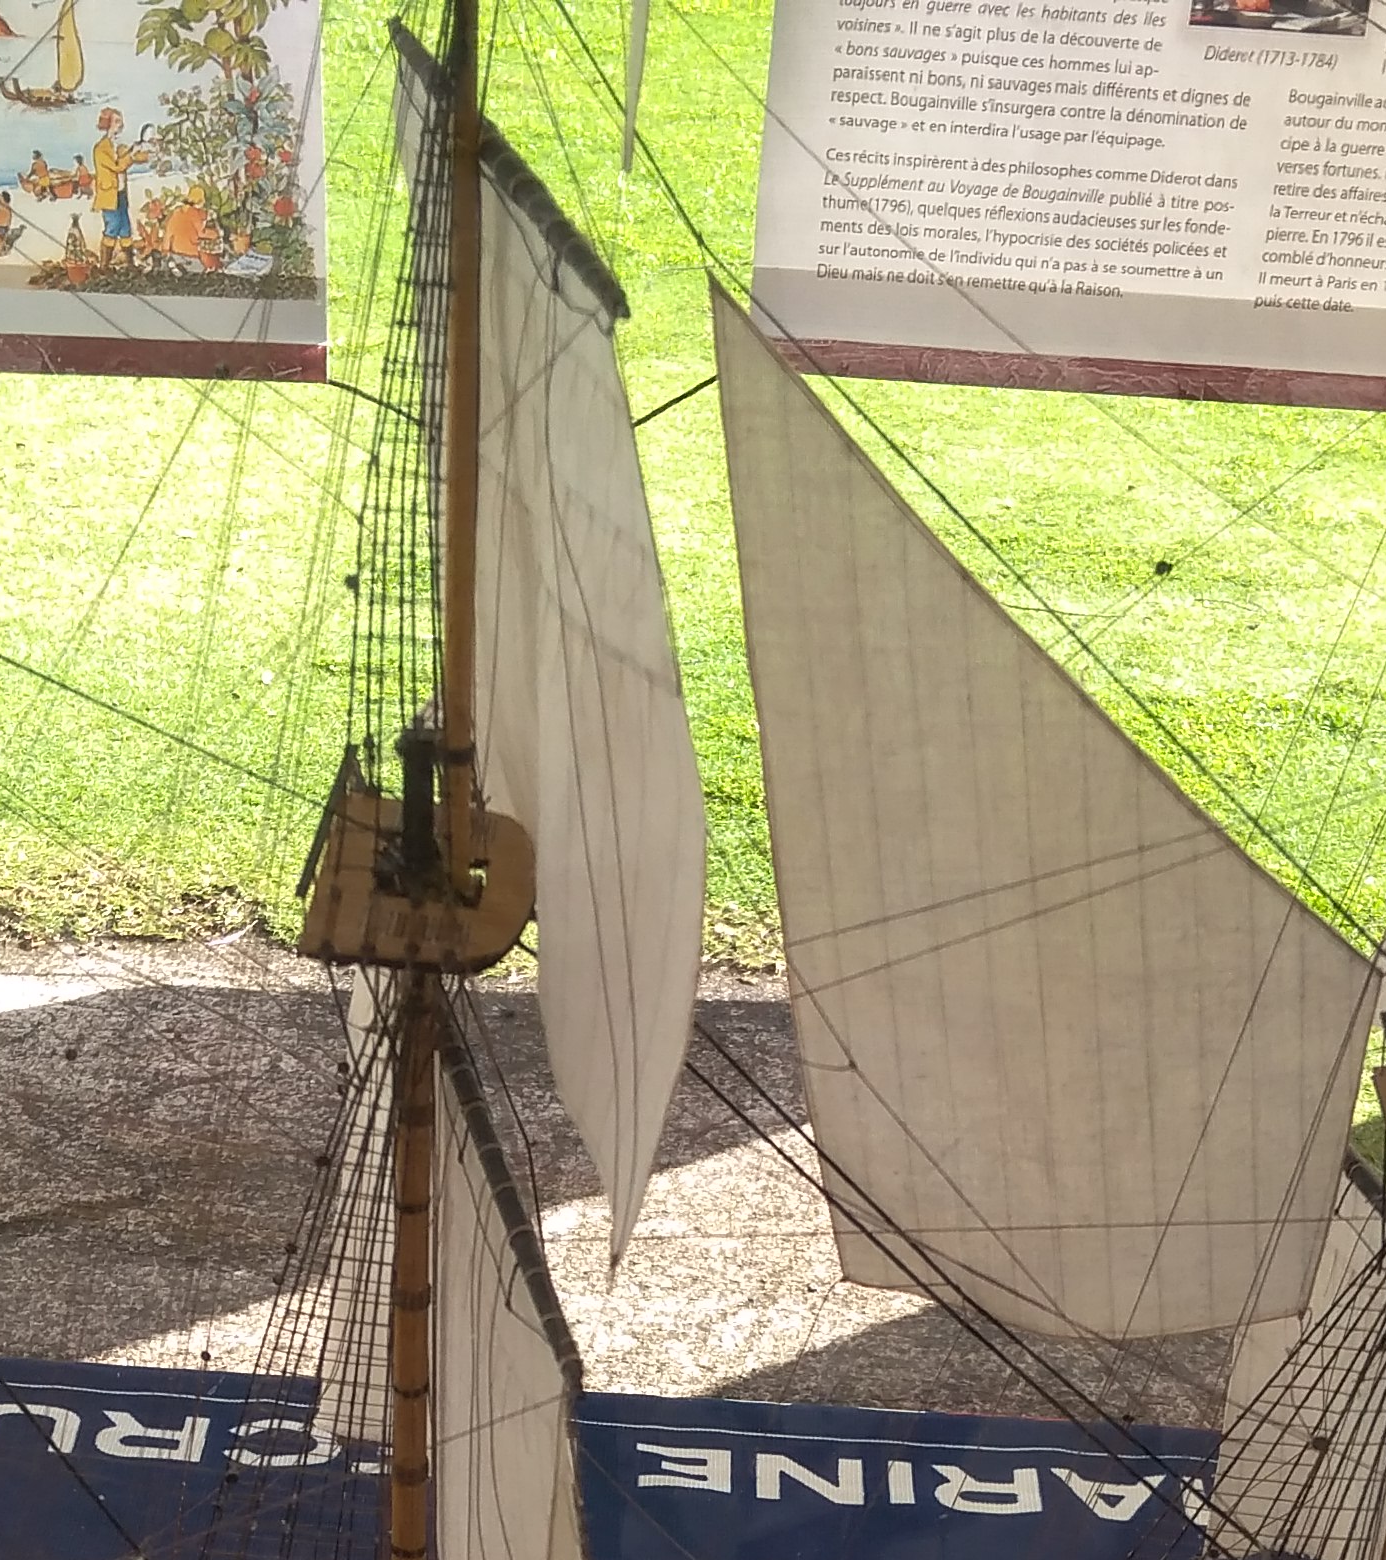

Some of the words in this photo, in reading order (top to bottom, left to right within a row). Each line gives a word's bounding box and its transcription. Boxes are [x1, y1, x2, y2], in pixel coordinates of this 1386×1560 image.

[926, 0, 972, 15] guerre
[978, 4, 1010, 17] avec
[1016, 2, 1035, 18] les
[1041, 4, 1107, 23] habitants
[1114, 10, 1137, 25] des
[837, 19, 891, 33] voisines
[987, 28, 1016, 44] plus
[1060, 32, 1140, 50] découverte
[846, 41, 878, 56] bons
[883, 47, 946, 63] sauvages
[961, 52, 1018, 68] puisque
[1022, 57, 1044, 68] ces
[1049, 54, 1110, 73] hommes
[1114, 59, 1132, 74] lui
[1135, 63, 1159, 78] ap-
[833, 66, 905, 83] paraissent
[928, 71, 966, 88] bons,
[988, 77, 1052, 96] sauvages
[1055, 80, 1088, 95] mais
[1092, 81, 1158, 101] différents
[1181, 88, 1229, 107] dignes
[1288, 88, 1373, 109] Bougainville
[831, 89, 887, 107] respect.
[890, 91, 977, 113] Bougainville
[1060, 104, 1106, 120] contre
[1110, 105, 1122, 121] la
[1126, 108, 1225, 129] dénomination
[1284, 114, 1332, 129] autour
[839, 115, 897, 133] sauvage
[950, 120, 1008, 138] interdira
[1064, 132, 1087, 144] par
[1280, 136, 1310, 152] cipe
[1341, 142, 1385, 157] guerre
[825, 148, 851, 162] Ces
[853, 149, 890, 165] récits
[893, 152, 968, 171] inspirèrent
[982, 158, 1006, 173] des
[1008, 161, 1093, 180] philosophes
[1095, 169, 1148, 183] comme
[1150, 170, 1202, 187] Diderot
[1205, 174, 1238, 189] dans
[1277, 160, 1319, 176] verses
[1323, 161, 1383, 180] fortunes.
[950, 179, 998, 198] Voyage
[1022, 184, 1104, 205] Bougainville
[1109, 189, 1153, 208] publié
[1171, 194, 1199, 210] titre
[1204, 198, 1235, 213] pos-
[1273, 182, 1310, 197] retire
[1313, 183, 1337, 200] des
[918, 201, 981, 220] quelques
[985, 205, 1050, 224] réflexions
[1052, 211, 1137, 230] audacieuses
[1139, 218, 1160, 231] sur
[1163, 218, 1182, 232] les
[1185, 216, 1231, 235] fonde-
[1284, 206, 1332, 222] Terreur
[820, 220, 863, 234] ments
[867, 221, 891, 236] des
[896, 222, 919, 237] lois
[923, 227, 981, 243] morales,
[1066, 234, 1090, 249] des
[1094, 237, 1149, 253] sociétés
[1153, 241, 1209, 258] policées
[1265, 227, 1309, 244] pierre.
[1332, 231, 1364, 247] 1796
[818, 243, 840, 255] sur
[1015, 256, 1037, 271] qui
[1063, 261, 1087, 274] pas
[1102, 264, 1117, 274] se
[1121, 263, 1190, 279] soumettre
[1262, 249, 1313, 264] comblé
[816, 264, 848, 279] Dieu
[852, 266, 884, 282] mais
[907, 269, 935, 285] doit
[966, 274, 1026, 291] remettre
[1075, 280, 1123, 299] Raison.
[1269, 272, 1312, 287] meurt
[1327, 275, 1357, 290] Paris
[1253, 294, 1284, 309] puis
[1285, 296, 1320, 311] cette
[1323, 297, 1354, 312] date.
